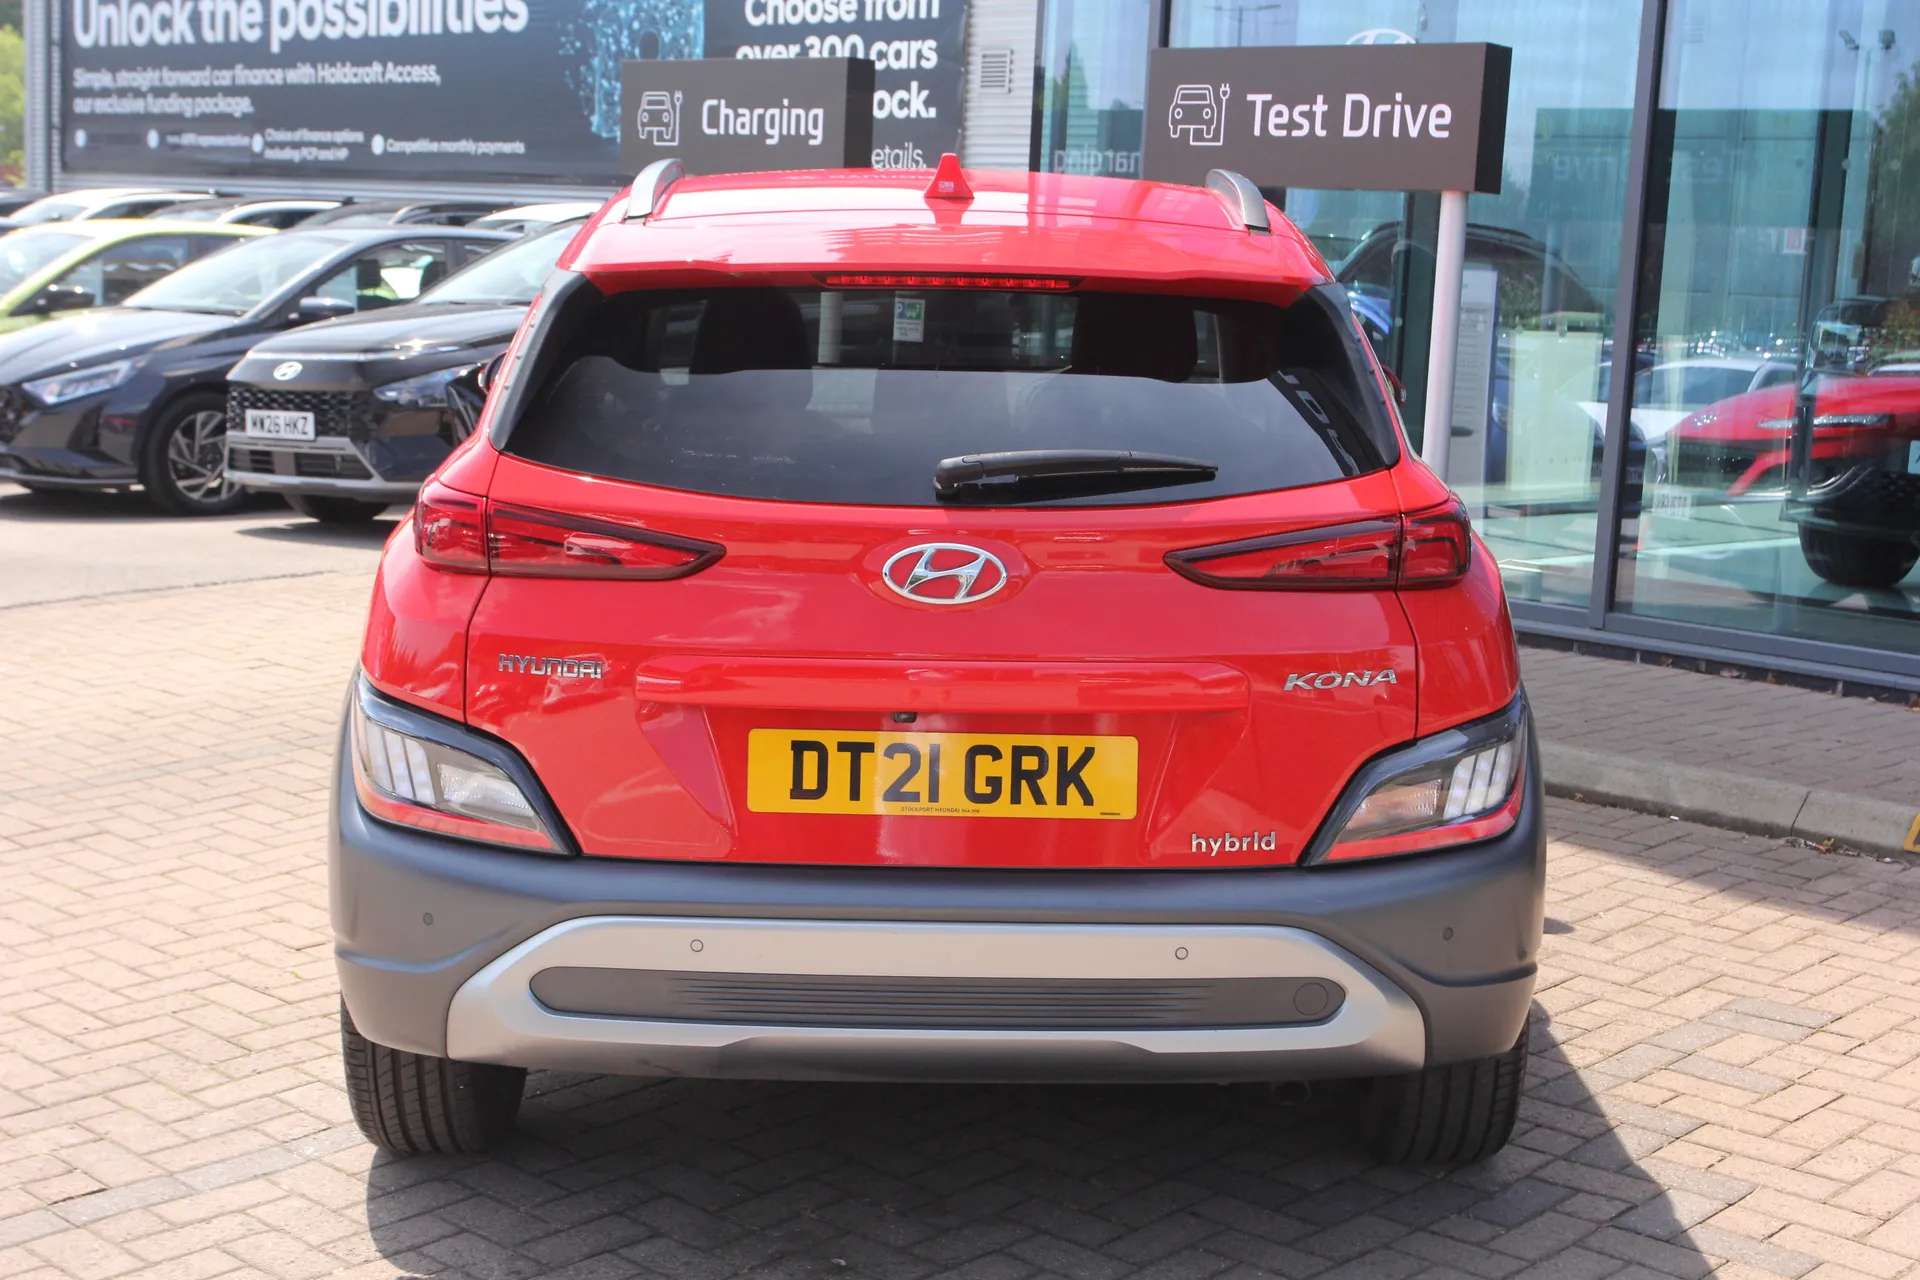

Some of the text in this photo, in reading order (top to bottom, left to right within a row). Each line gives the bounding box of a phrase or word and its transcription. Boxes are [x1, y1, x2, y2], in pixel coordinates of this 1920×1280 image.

[744, 0, 940, 26] Choose from
[73, 0, 529, 54] Unlock the possibilities
[870, 38, 938, 70] cars
[235, 63, 284, 86] finance
[285, 62, 316, 85] with
[317, 61, 384, 84] Holdcroft
[384, 61, 442, 87] Access,
[701, 98, 825, 146] Charging
[1246, 92, 1453, 139] Test Drive
[283, 416, 309, 436] HKZ
[497, 653, 603, 679] HYUNDAI
[1283, 669, 1398, 691] KONA
[789, 739, 1096, 806] DT21 GRK
[1190, 831, 1276, 857] hybrid
